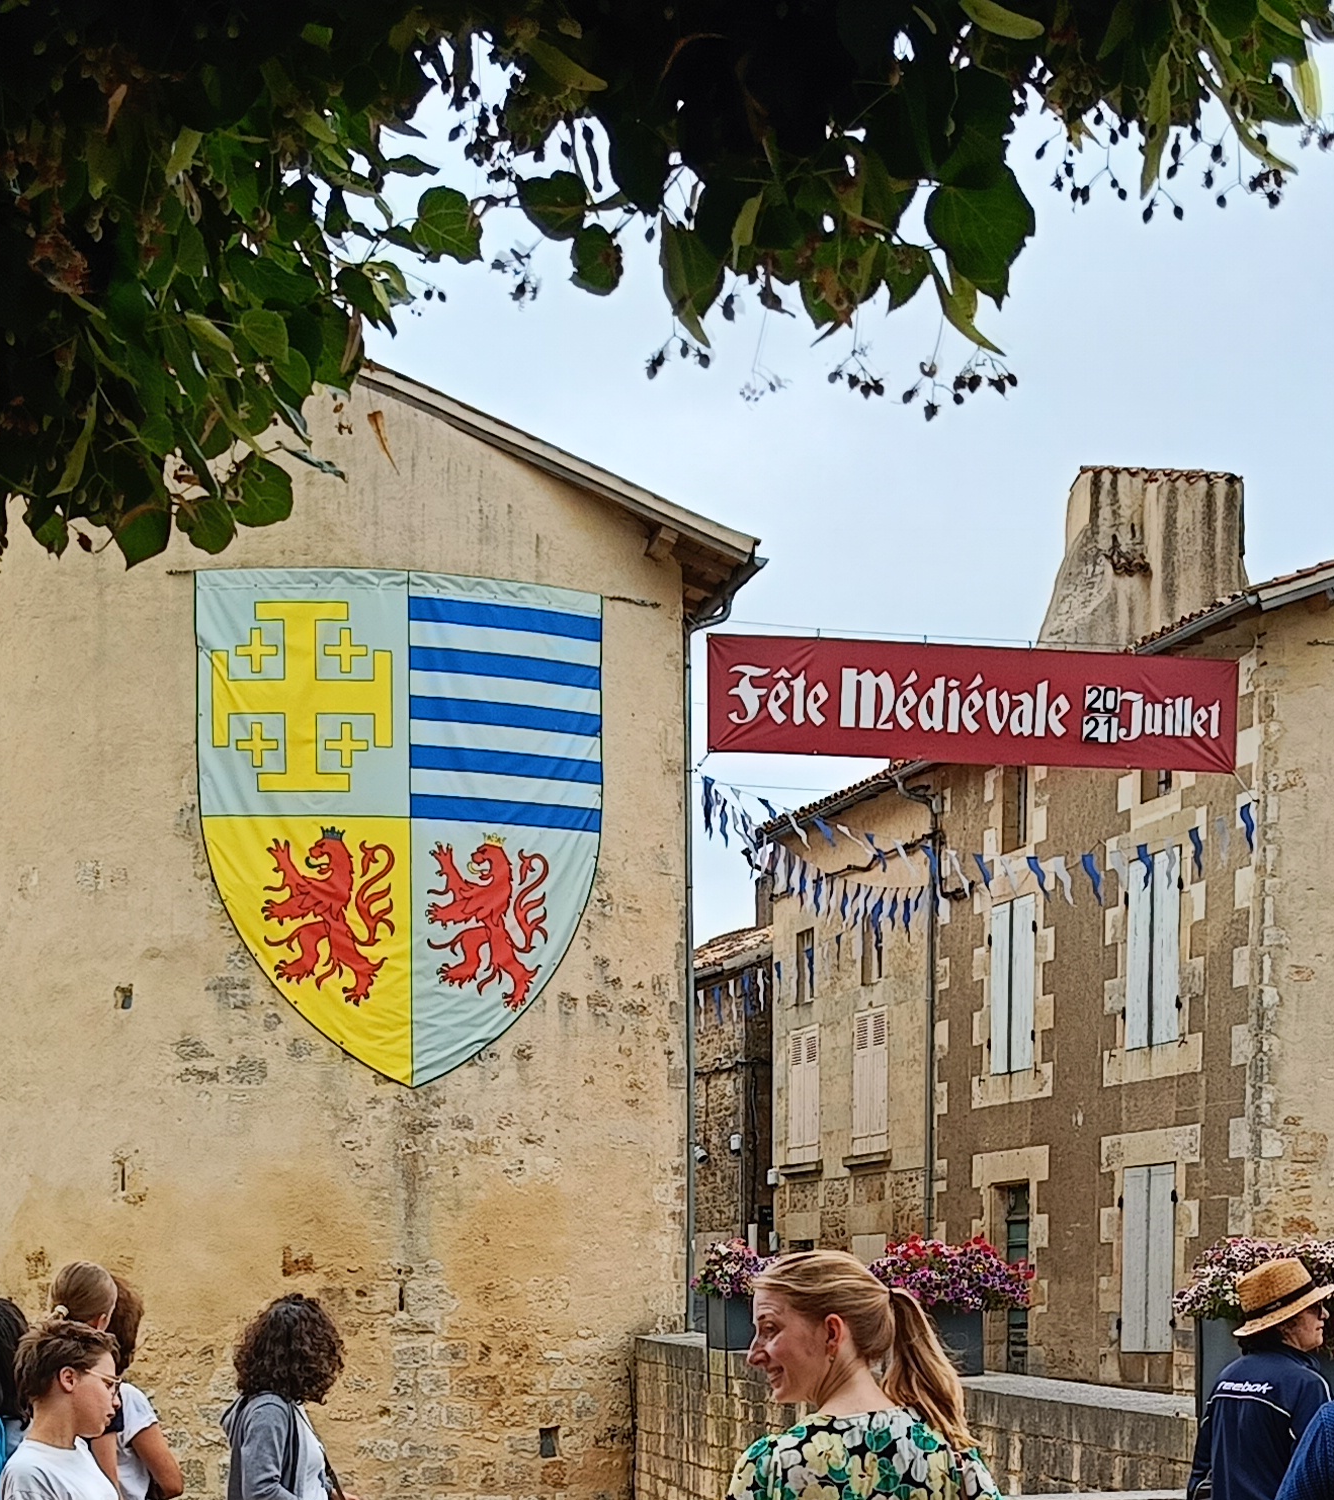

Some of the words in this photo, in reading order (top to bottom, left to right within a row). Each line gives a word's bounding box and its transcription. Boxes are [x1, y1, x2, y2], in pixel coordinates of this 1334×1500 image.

[728, 664, 829, 727] Fête
[840, 667, 1070, 738] Médiévale
[1086, 686, 1119, 713] 20
[1119, 691, 1221, 741] Juillet
[1084, 716, 1113, 743] 21
